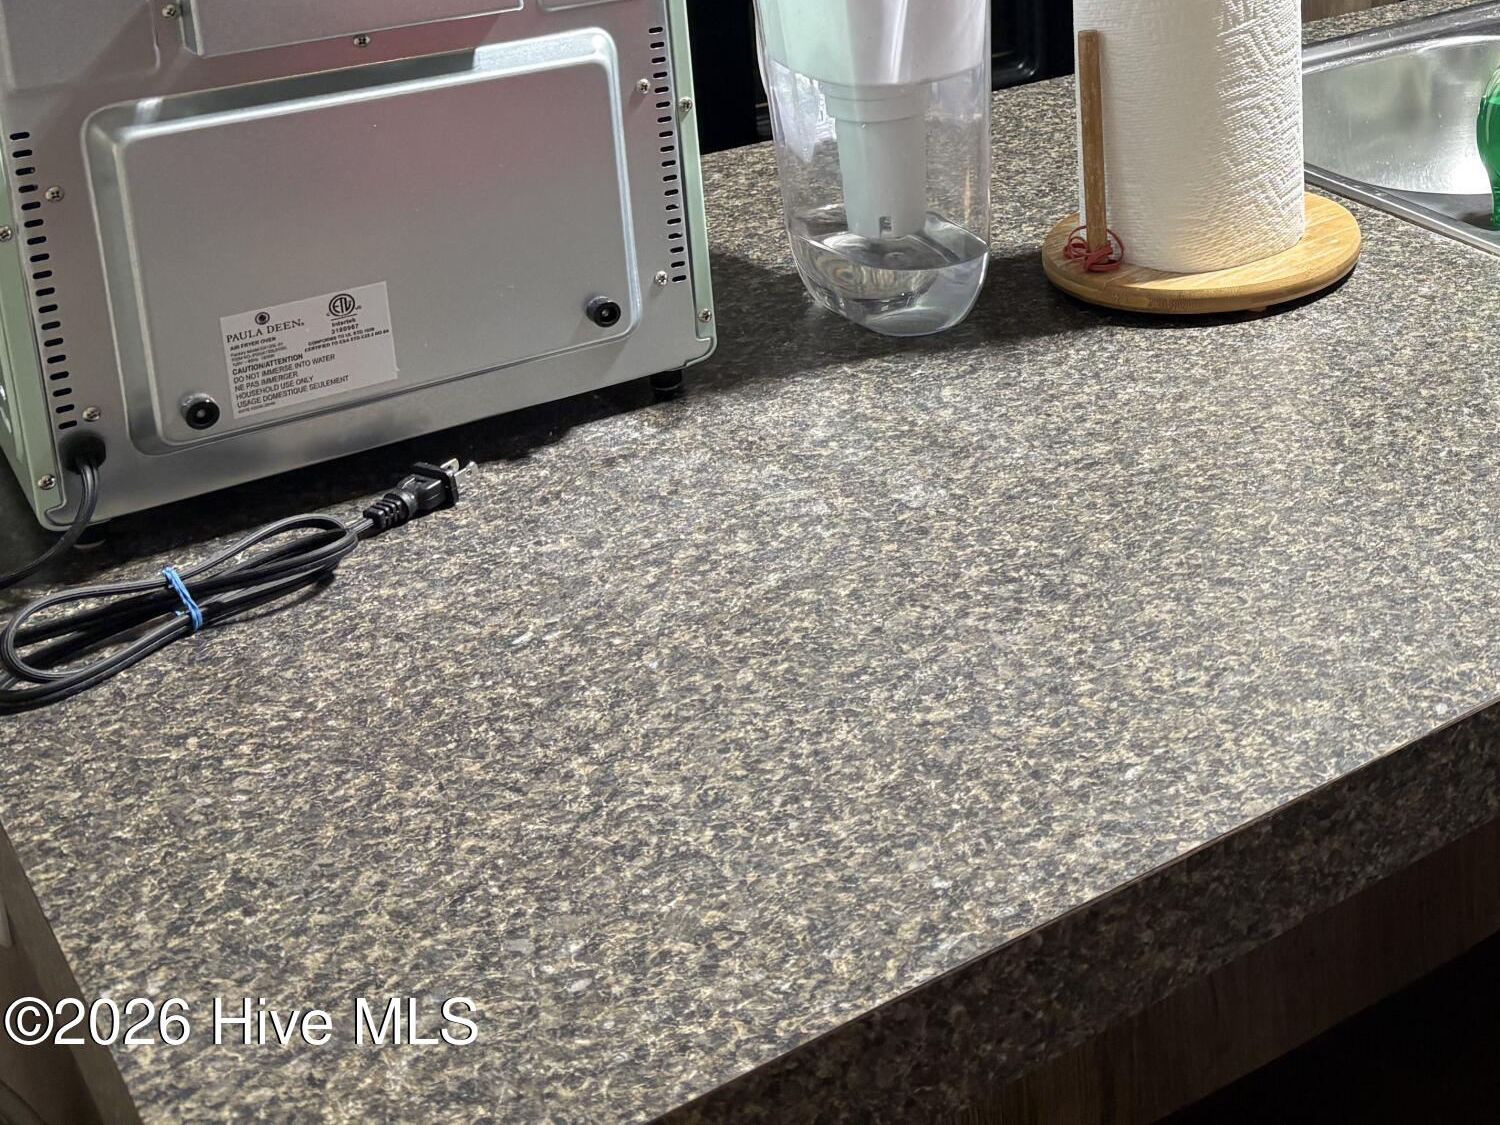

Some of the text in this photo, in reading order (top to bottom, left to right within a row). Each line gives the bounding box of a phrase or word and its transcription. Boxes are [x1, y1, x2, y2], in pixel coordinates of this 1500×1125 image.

[226, 328, 263, 343] PAULA
[232, 353, 303, 376] CAUTION/ATTENTION
[233, 354, 336, 384] DO NOT IMMERSE INTO WATER
[234, 371, 299, 392] NE PAS IMMERGER
[236, 375, 315, 400] HOUSEHOLD USE ONLY
[237, 395, 263, 409] USAGE
[262, 385, 308, 403] DOMESTIQUE
[309, 375, 349, 391] SEULEMENT
